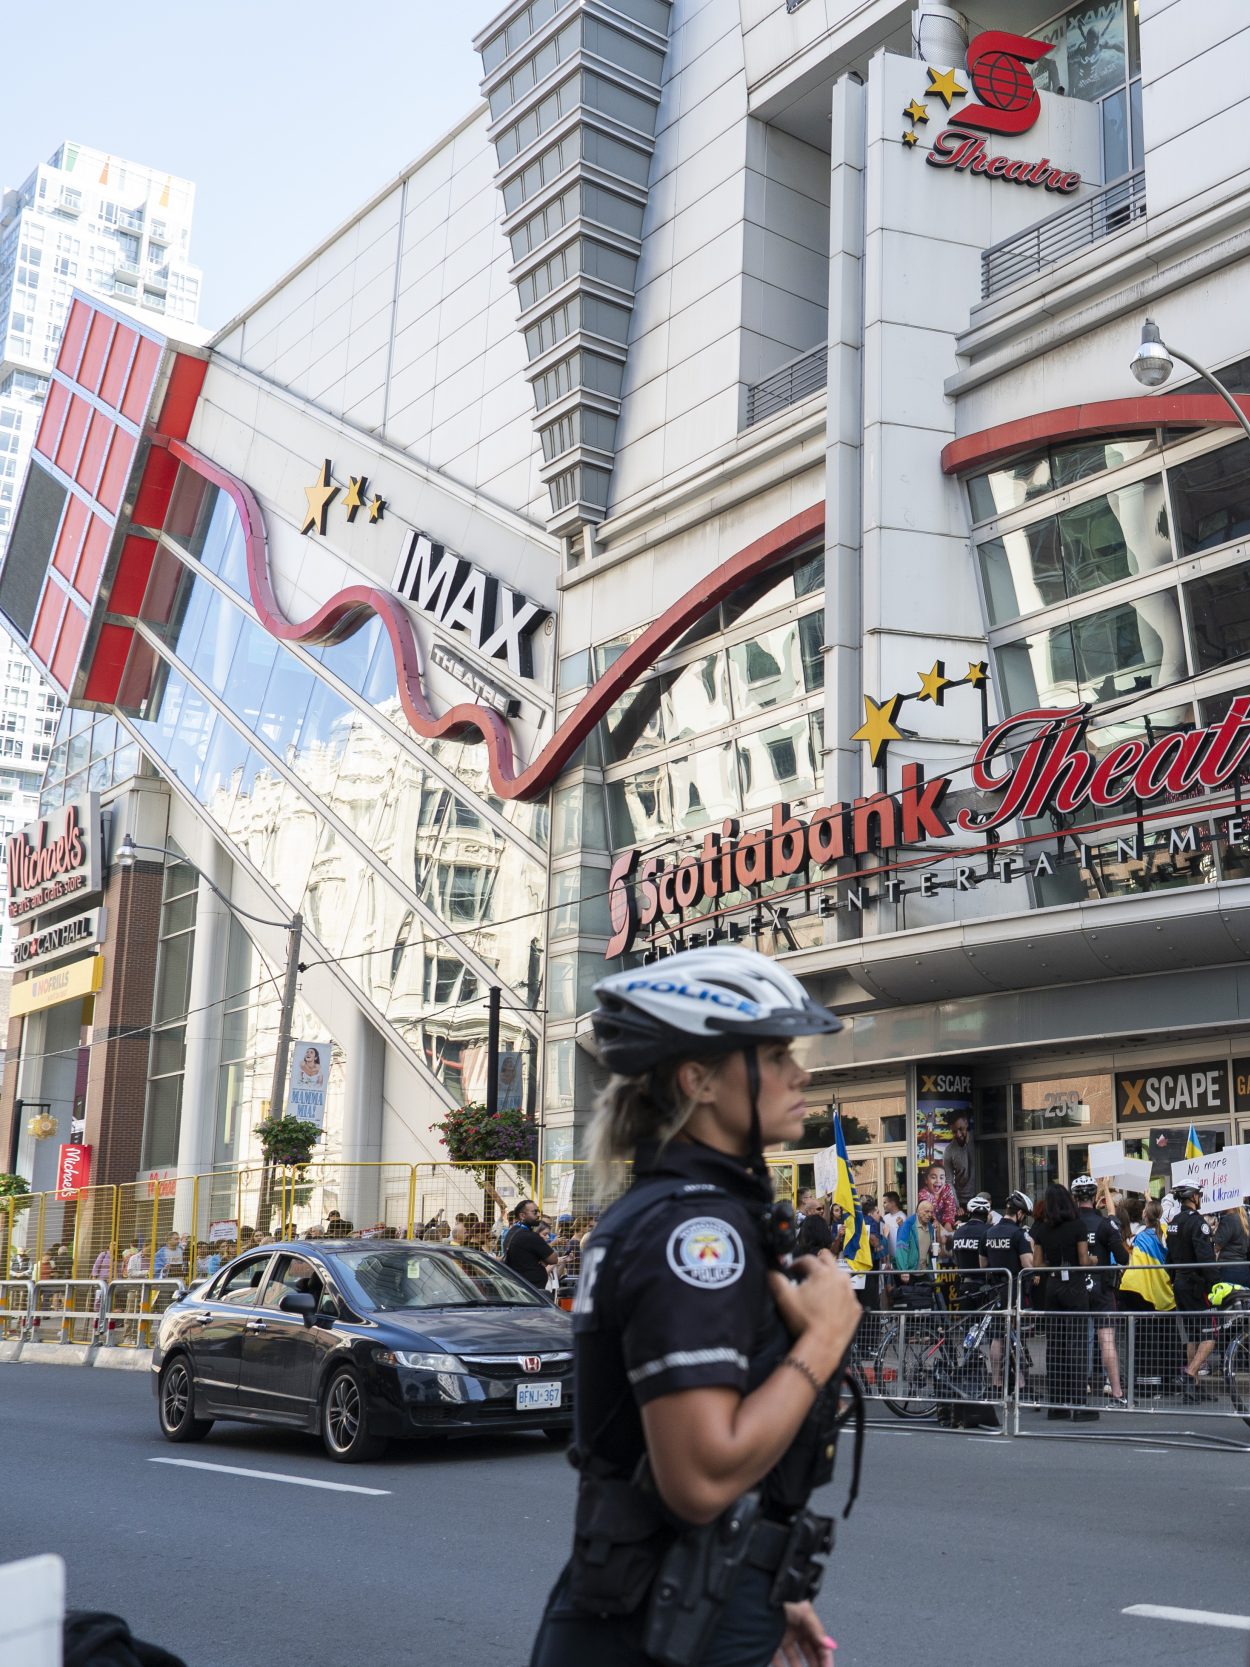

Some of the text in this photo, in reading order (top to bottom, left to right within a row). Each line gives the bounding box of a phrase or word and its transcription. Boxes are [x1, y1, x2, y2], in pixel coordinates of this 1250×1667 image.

[926, 129, 1082, 194] Theatre
[391, 528, 552, 679] IMAX
[434, 647, 507, 713] THEATRE
[8, 804, 85, 898] Michaels
[642, 763, 955, 925] Scotiabank
[61, 917, 91, 944] HALL
[643, 907, 789, 968] CINEPLEX
[627, 980, 761, 1018] POLICE
[921, 1074, 972, 1094] XSCAPE
[1044, 1090, 1082, 1118] 259
[1122, 1070, 1221, 1116] XSCAPE
[61, 1147, 81, 1198] Michaels
[1188, 1158, 1227, 1175] No more
[1213, 1172, 1228, 1186] Lies
[953, 1239, 979, 1249] POLICE
[986, 1239, 1010, 1249] POLICE
